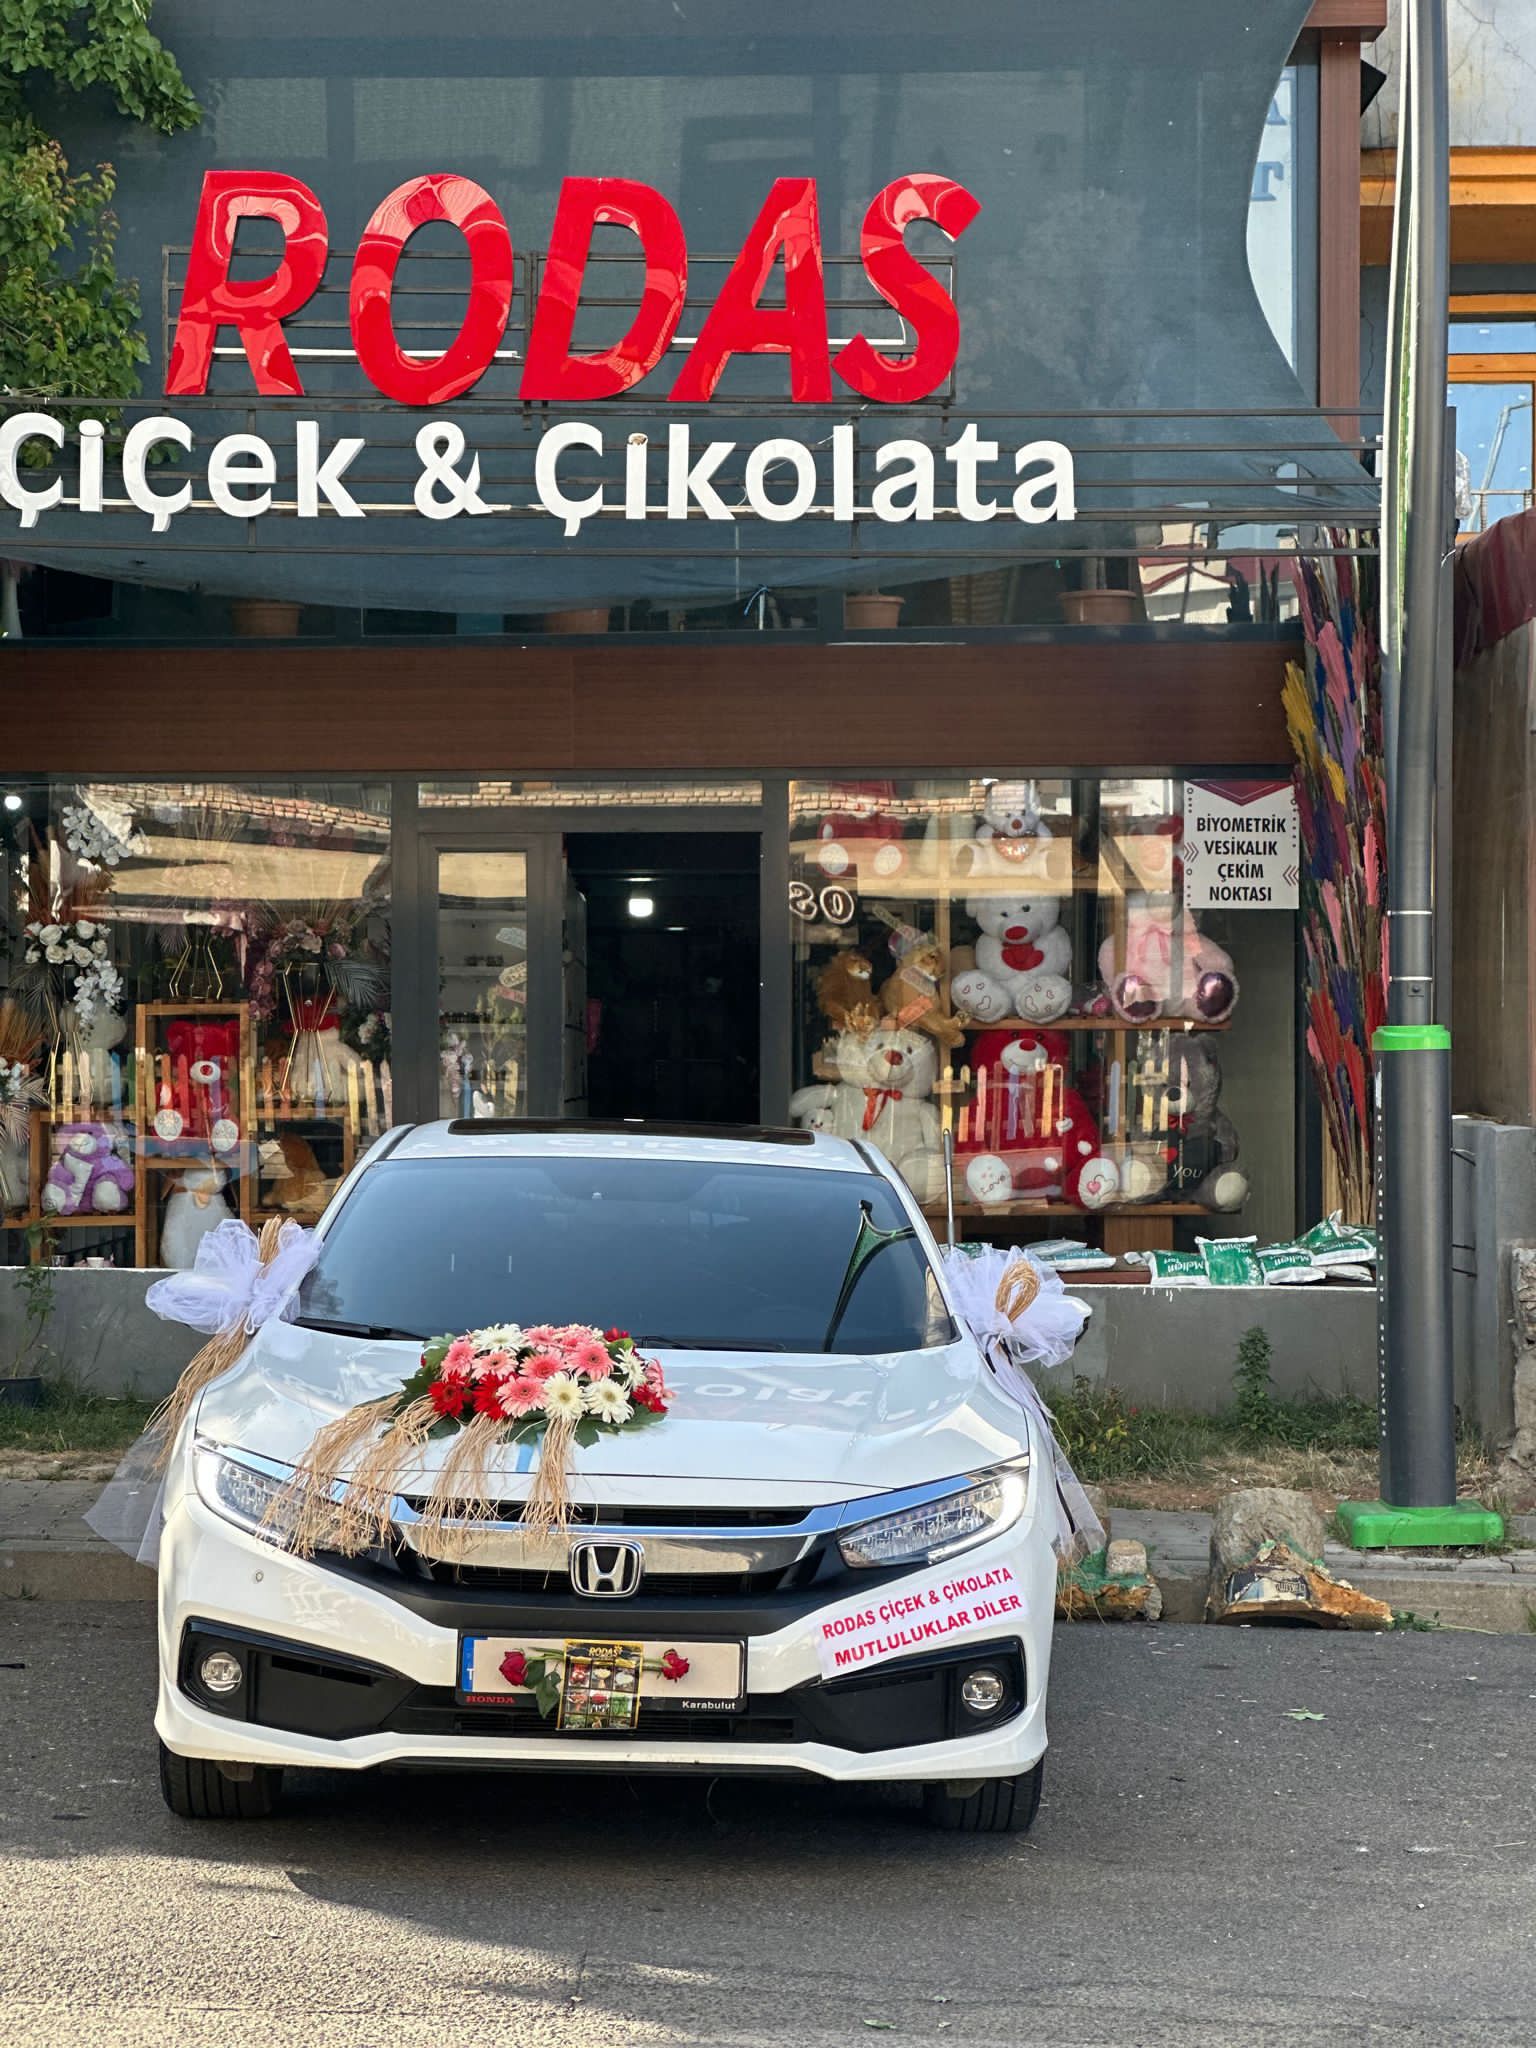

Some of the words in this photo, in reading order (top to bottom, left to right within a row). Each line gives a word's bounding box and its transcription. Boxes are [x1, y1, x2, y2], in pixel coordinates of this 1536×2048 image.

[164, 169, 982, 406] RODAS
[413, 421, 493, 520] &
[1196, 813, 1287, 833] BİYOMETRİK
[1204, 837, 1278, 856] VESİKALIK
[1217, 859, 1265, 882] ÇEKİM
[1209, 886, 1272, 901] NOKTASI
[821, 1610, 876, 1639] RODAS
[879, 1594, 925, 1624] ÇİÇEK
[928, 1590, 940, 1605] &
[943, 1567, 1013, 1601] ÇİKOLATA
[834, 1611, 971, 1666] MUTLULUKLAR
[973, 1595, 1022, 1621] DİLER
[465, 1695, 515, 1704] HONDA
[681, 1700, 736, 1710] Karabulut
